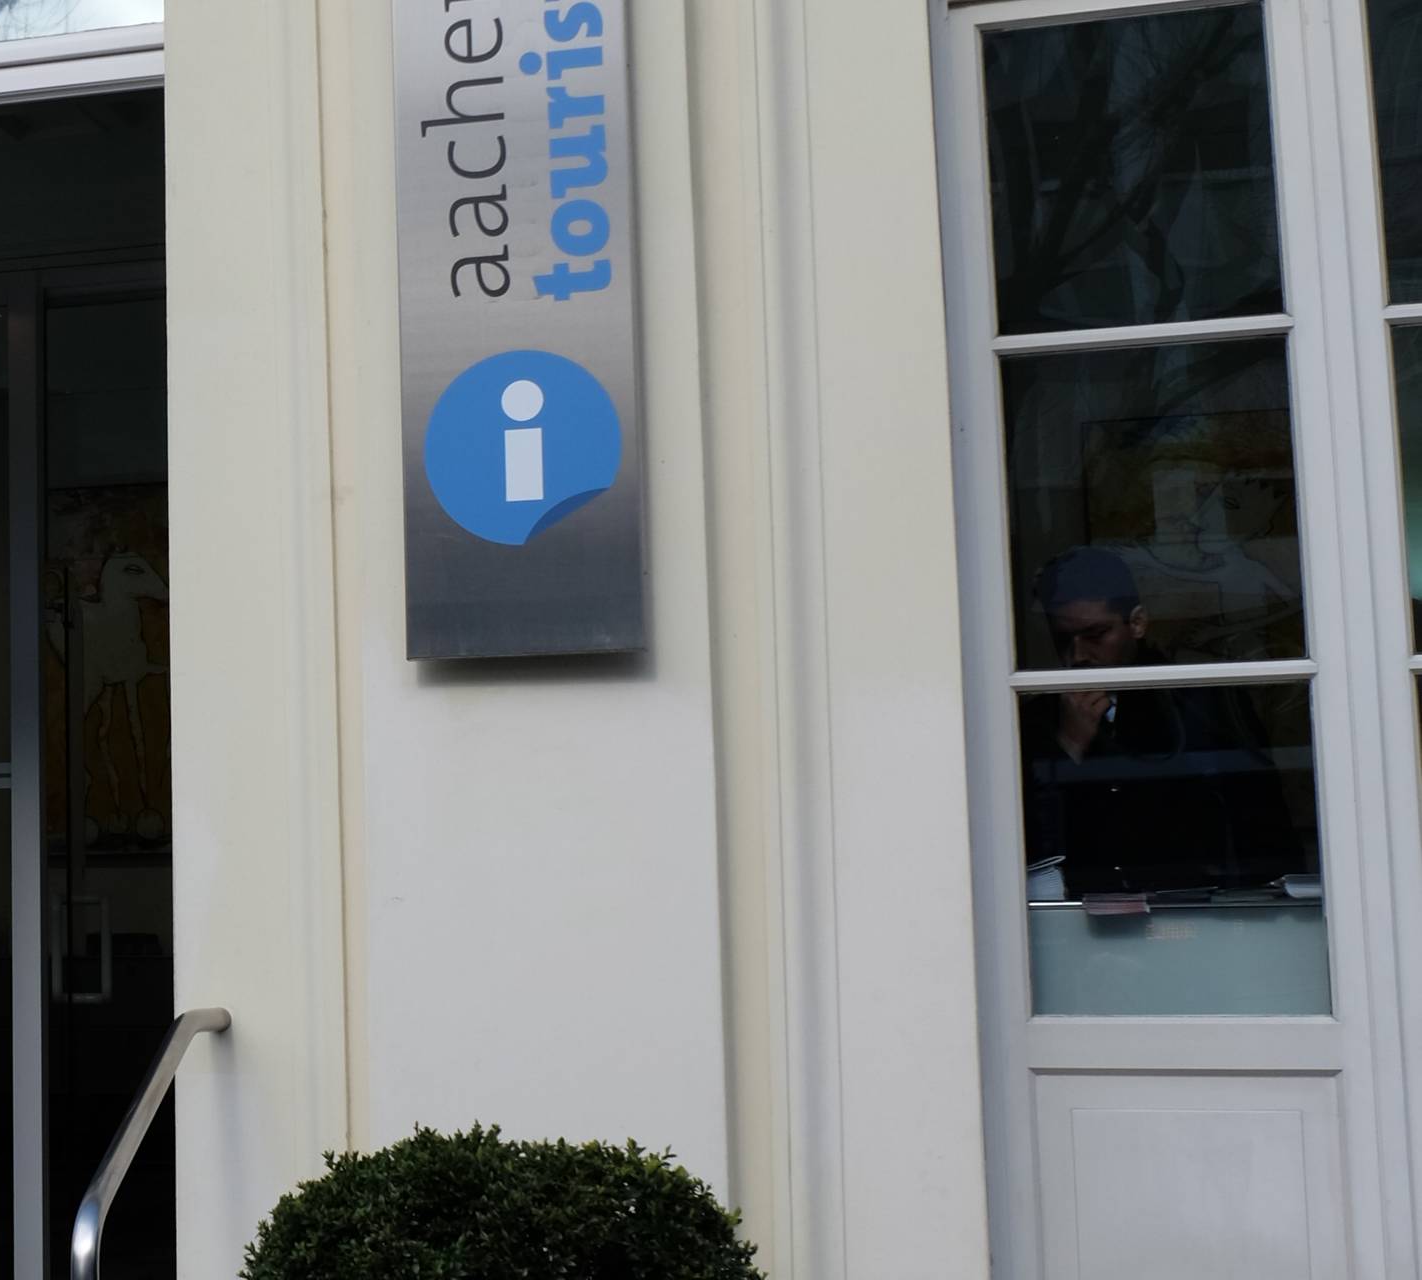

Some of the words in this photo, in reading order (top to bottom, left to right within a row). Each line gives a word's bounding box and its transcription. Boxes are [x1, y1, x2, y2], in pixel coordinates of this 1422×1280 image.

[421, 0, 511, 299] aache
[518, 0, 613, 301] touris
[501, 380, 544, 502] i
